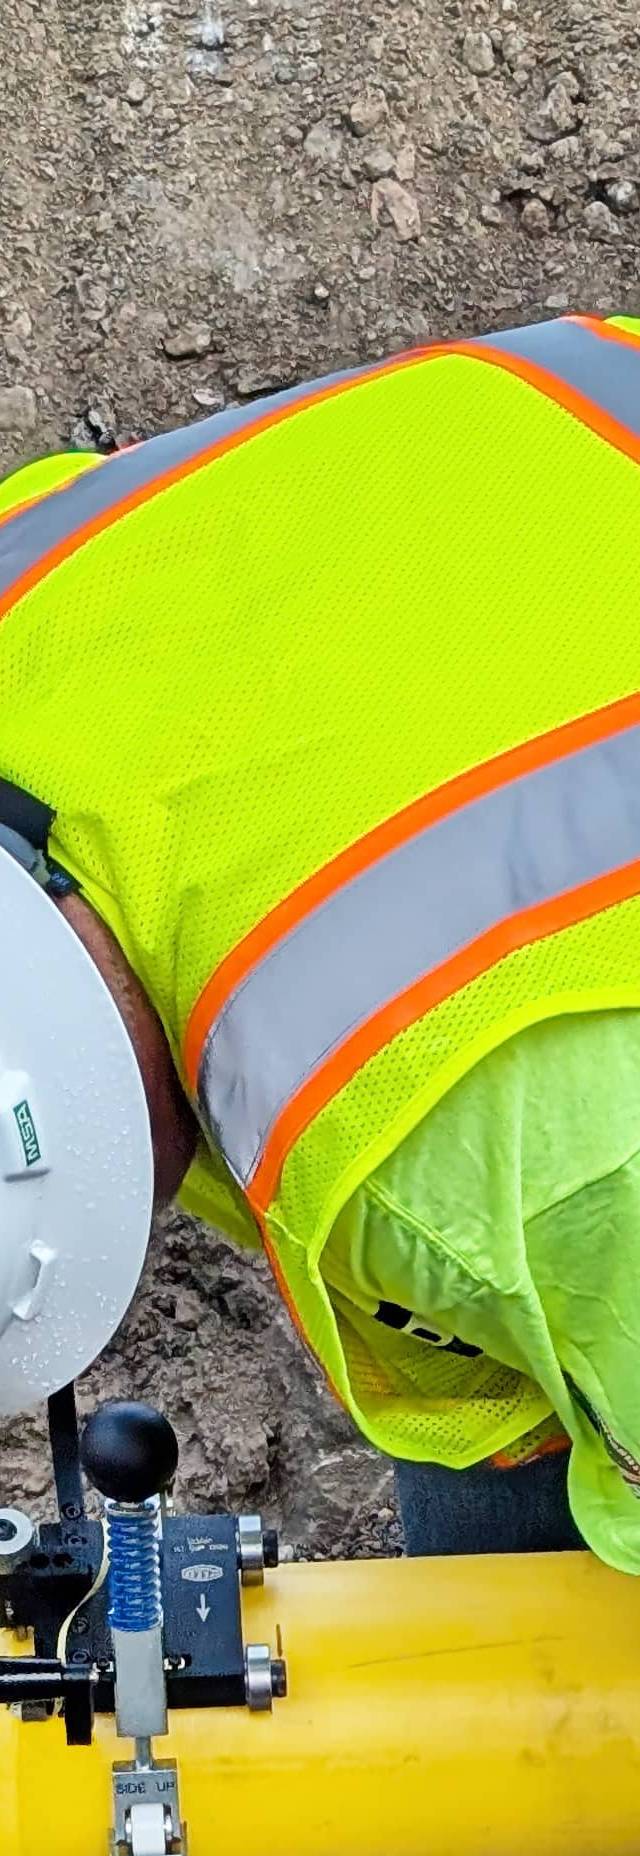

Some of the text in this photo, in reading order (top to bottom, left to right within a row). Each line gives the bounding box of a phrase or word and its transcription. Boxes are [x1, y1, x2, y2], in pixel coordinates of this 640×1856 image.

[16, 1102, 39, 1162] MSA
[116, 1781, 175, 1794] SIDE UP
